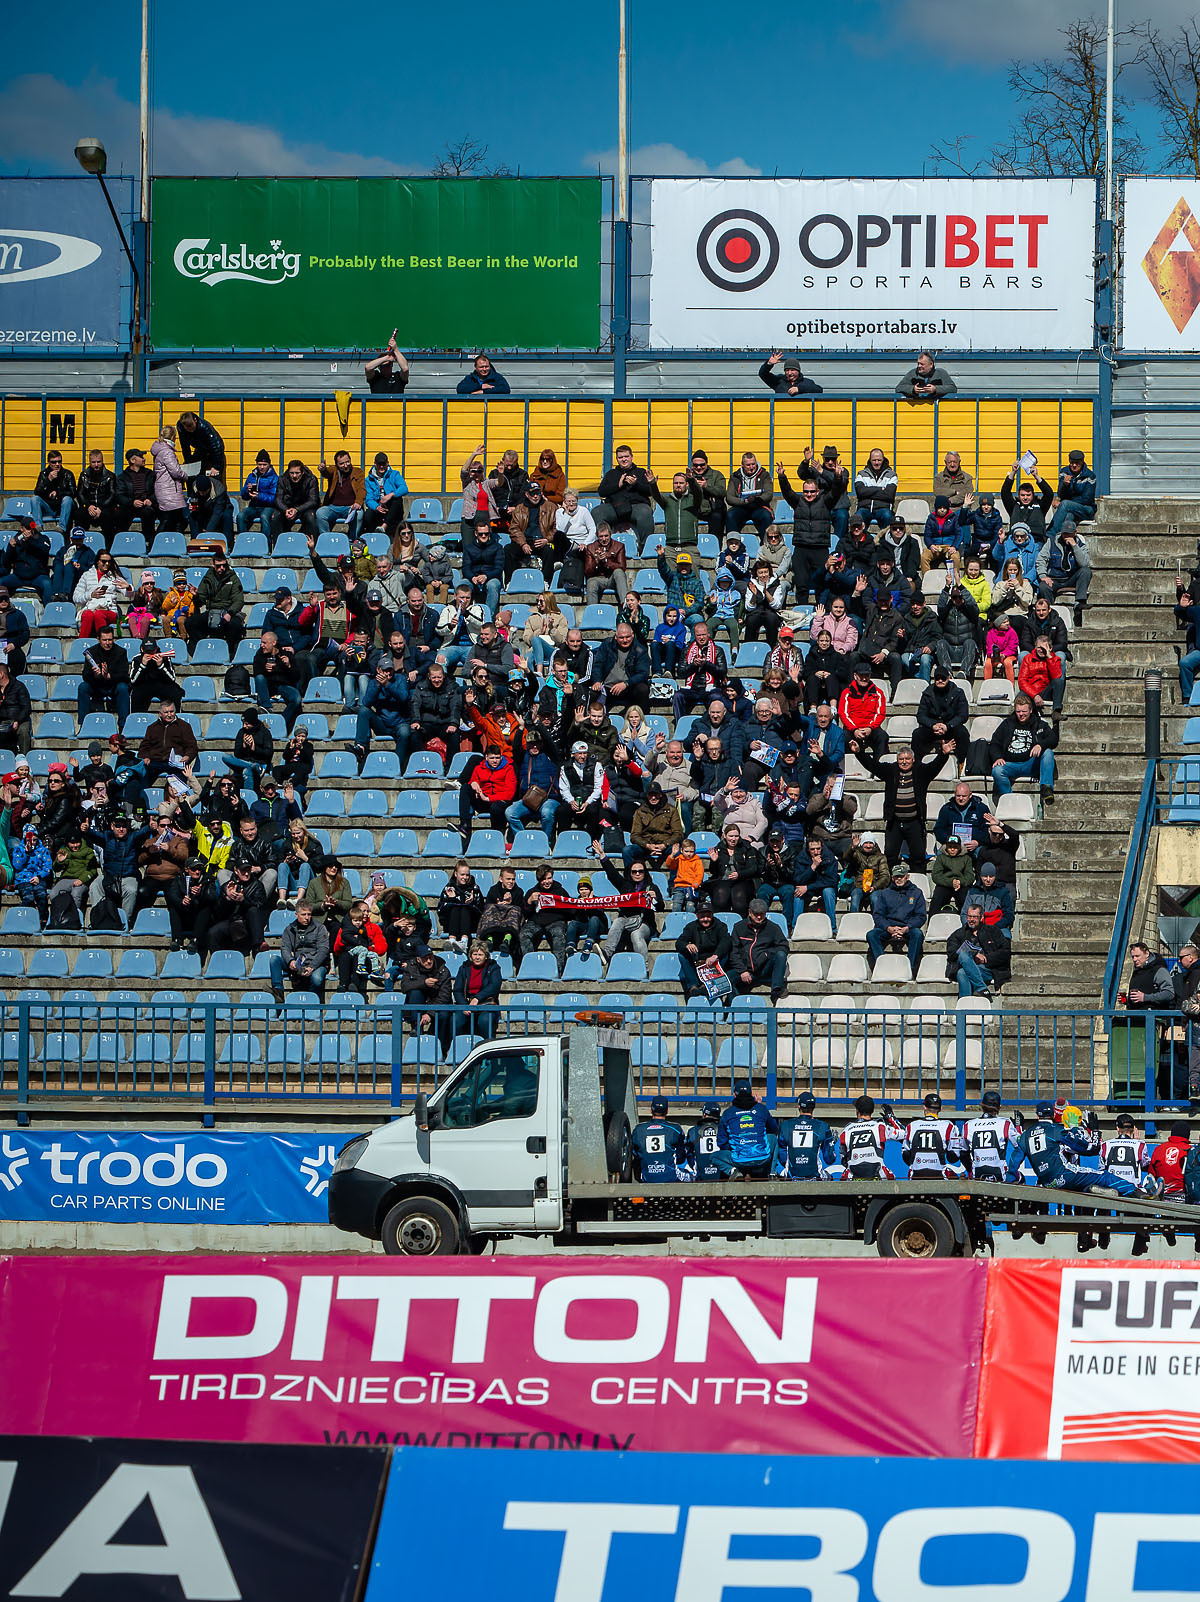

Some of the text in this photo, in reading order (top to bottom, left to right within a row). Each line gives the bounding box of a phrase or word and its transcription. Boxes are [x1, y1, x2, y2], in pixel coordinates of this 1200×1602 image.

[799, 213, 1048, 269] OPTIBET
[174, 238, 302, 282] Carlsberg
[309, 255, 579, 271] Probably the Best Beer in the World
[803, 274, 1044, 289] SPORTA BĀRS
[786, 319, 958, 340] optibetsportabars.lv
[50, 413, 75, 445] M
[560, 894, 632, 906] LOKOMOTIV
[651, 1136, 661, 1152] 3
[705, 1136, 714, 1152] 6
[799, 1131, 807, 1147] 7
[853, 1133, 871, 1144] 13
[920, 1133, 933, 1148] 11
[978, 1132, 991, 1147] 12
[1034, 1137, 1041, 1151] 5
[1117, 1147, 1125, 1162] 9
[40, 1143, 228, 1188] trodo
[50, 1194, 226, 1211] CAR PARTS ONLINE
[152, 1274, 819, 1364] DITTON
[1067, 1354, 1128, 1376] MADE
[1137, 1355, 1157, 1376] IN
[149, 1372, 809, 1406] TIRDZNIECĪBAS CENTRS
[0, 1461, 243, 1601] A
